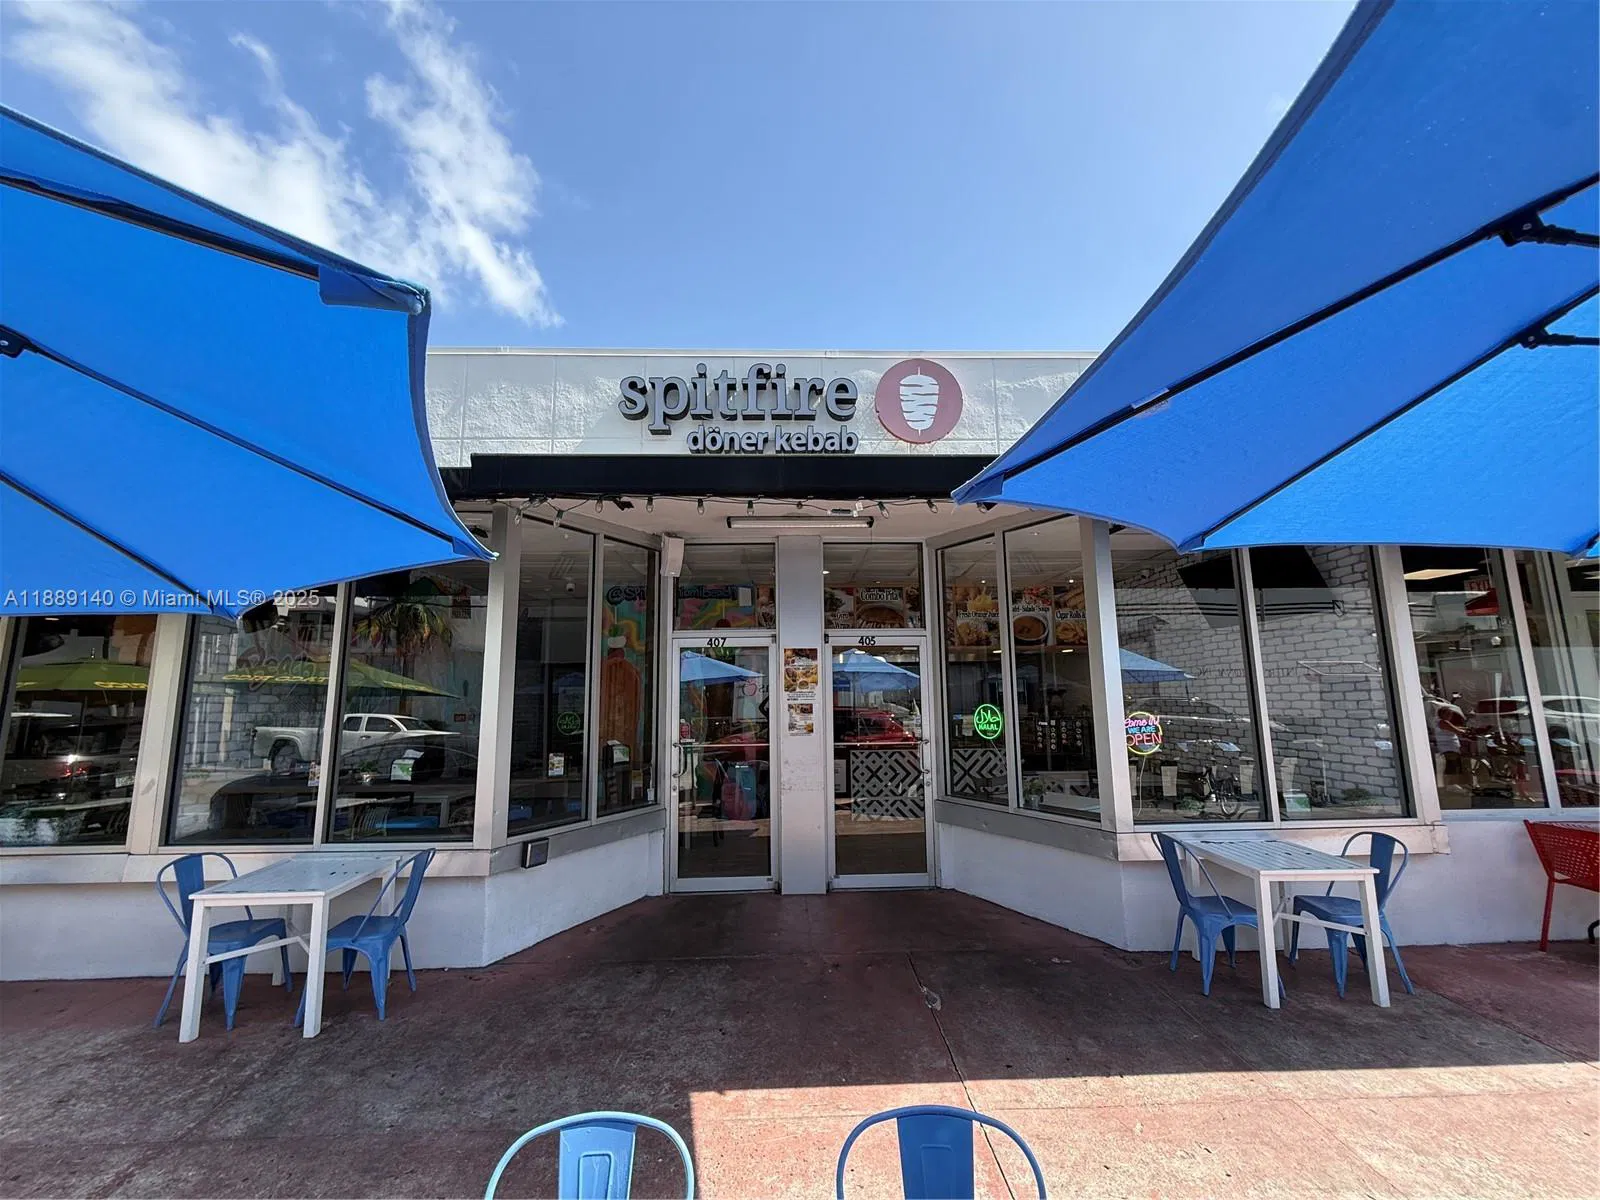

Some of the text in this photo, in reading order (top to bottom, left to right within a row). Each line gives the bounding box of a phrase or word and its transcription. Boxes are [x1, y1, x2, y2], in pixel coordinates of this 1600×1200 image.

[619, 363, 859, 435] spitfire
[687, 426, 859, 454] döner kebab
[706, 637, 727, 648] 407
[858, 636, 876, 646] 405
[978, 723, 998, 731] HALAL
[1141, 725, 1156, 733] ARE
[1126, 733, 1162, 746] OPEN
